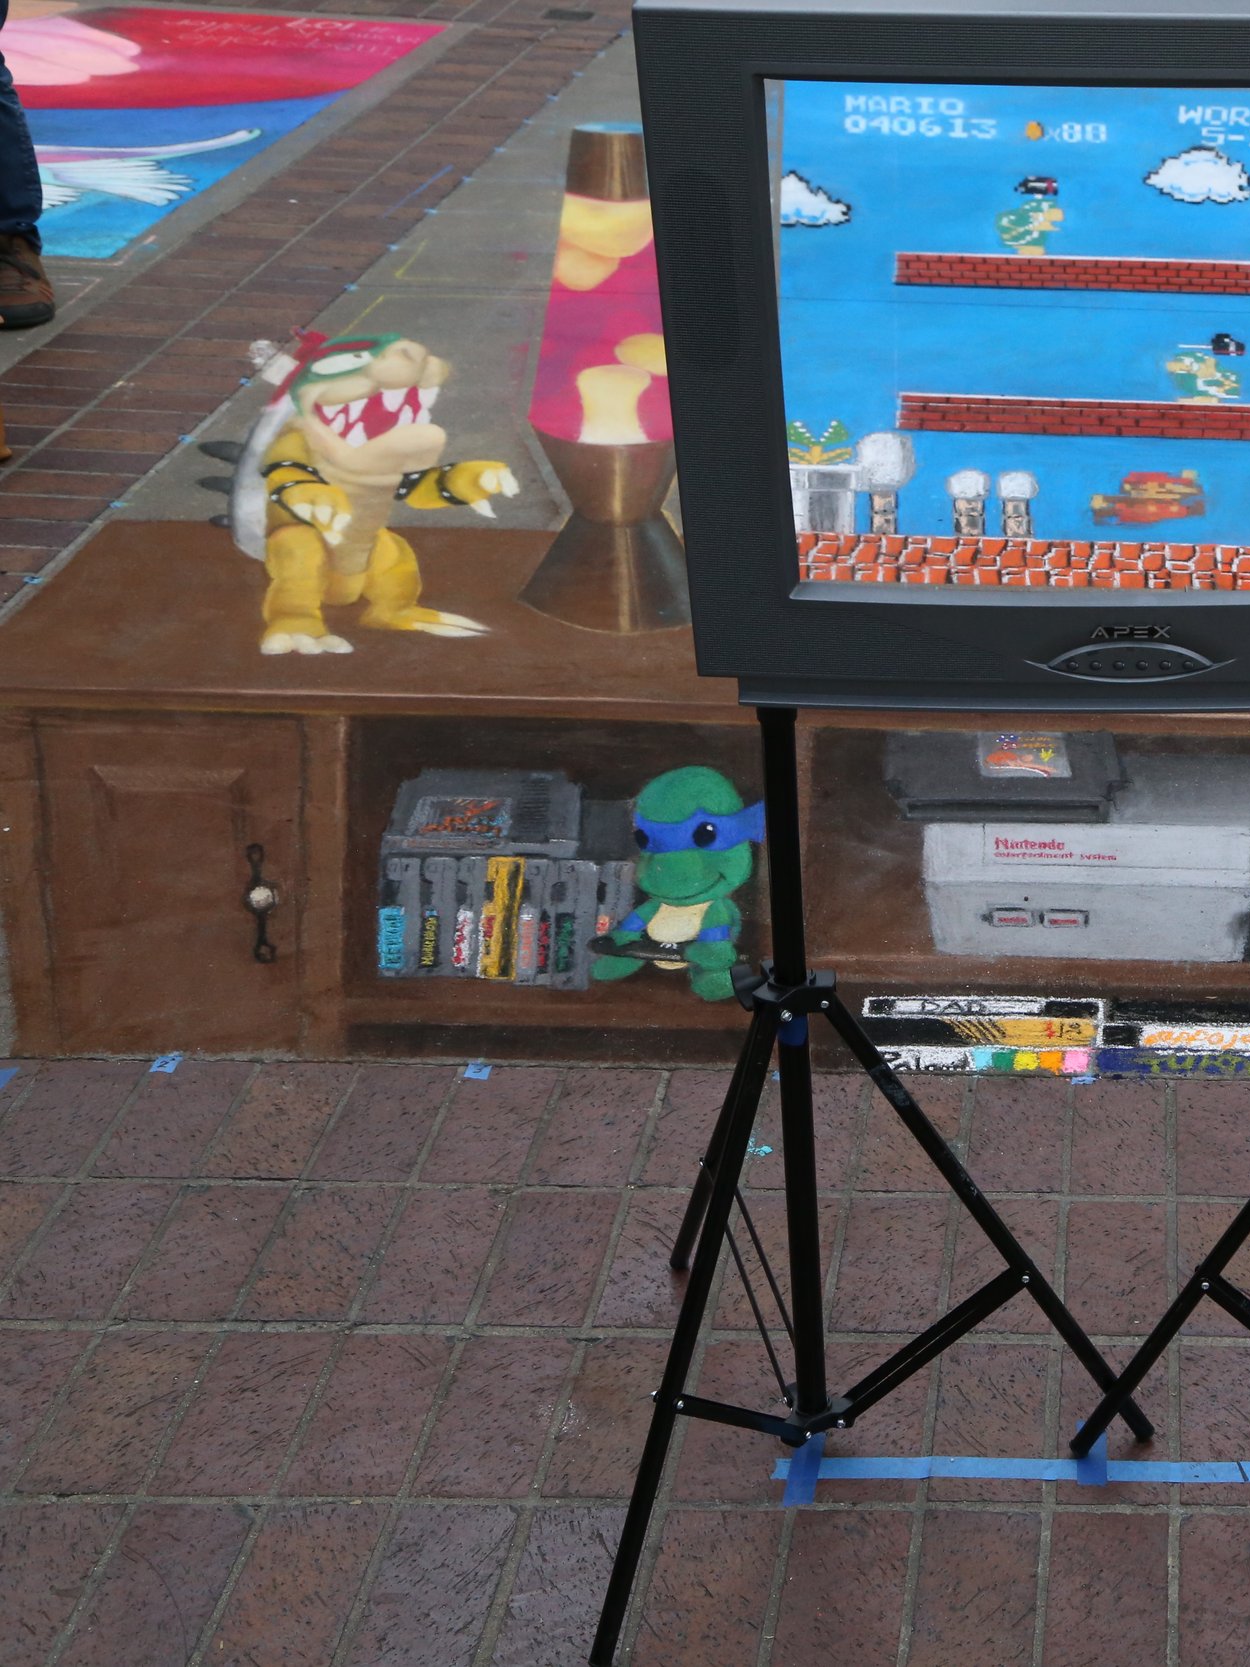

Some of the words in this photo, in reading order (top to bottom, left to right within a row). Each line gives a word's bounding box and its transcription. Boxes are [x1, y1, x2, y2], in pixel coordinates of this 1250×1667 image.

[843, 94, 966, 116] MARIO
[843, 115, 998, 140] 040613
[1090, 625, 1172, 640] APEX
[993, 836, 1066, 851] Nintendo
